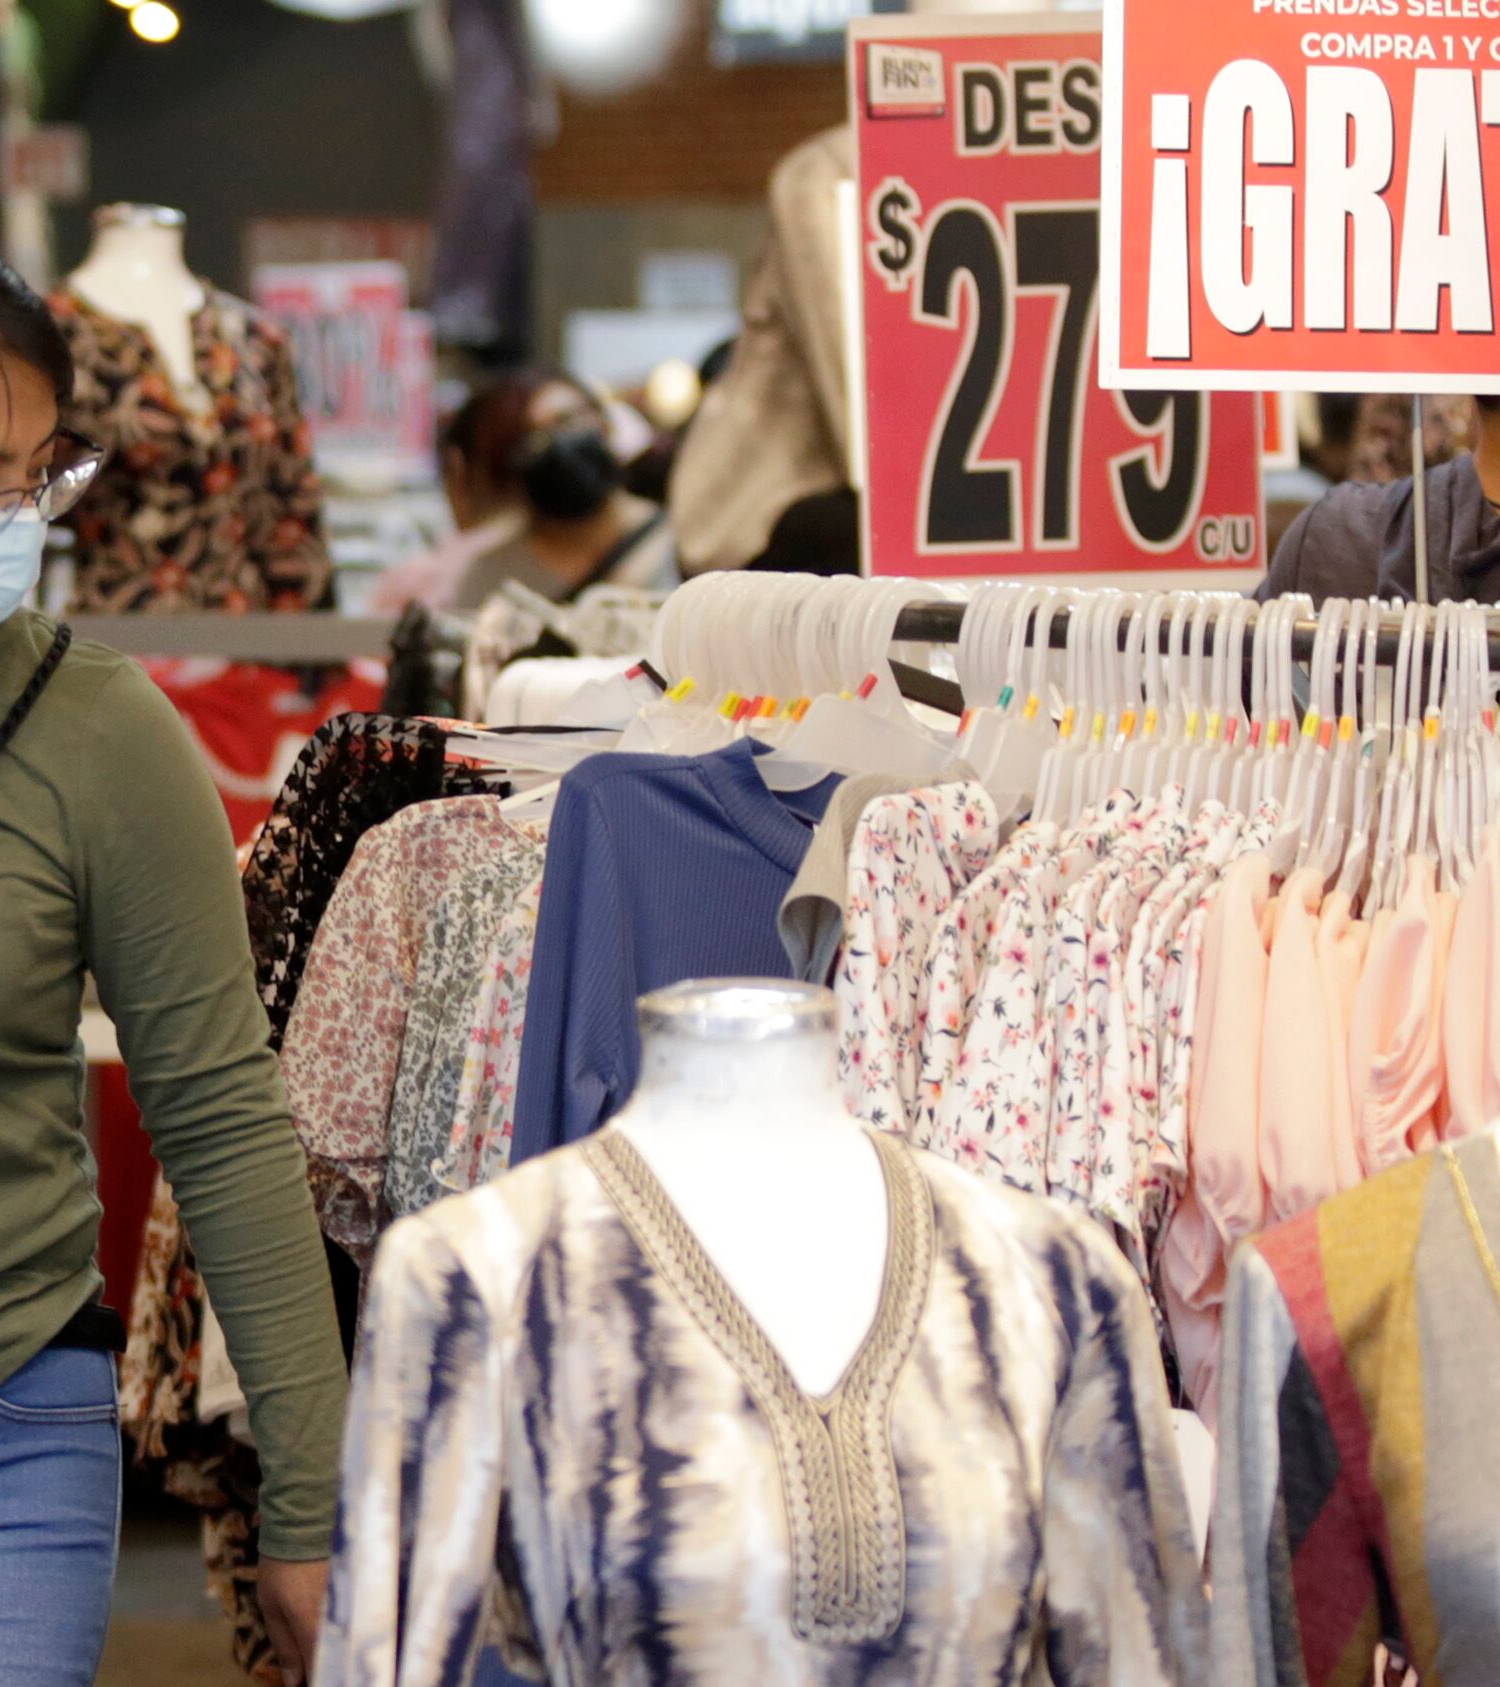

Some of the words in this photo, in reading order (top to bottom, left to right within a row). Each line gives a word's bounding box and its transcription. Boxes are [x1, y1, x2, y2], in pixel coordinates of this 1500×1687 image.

[1253, 0, 1399, 16] PRENDAS
[1300, 32, 1437, 60] COMPRA
[1442, 35, 1454, 61] 1
[1461, 36, 1482, 61] Y
[1147, 58, 1500, 360] ¡GRA
[1199, 518, 1253, 559] C/U
